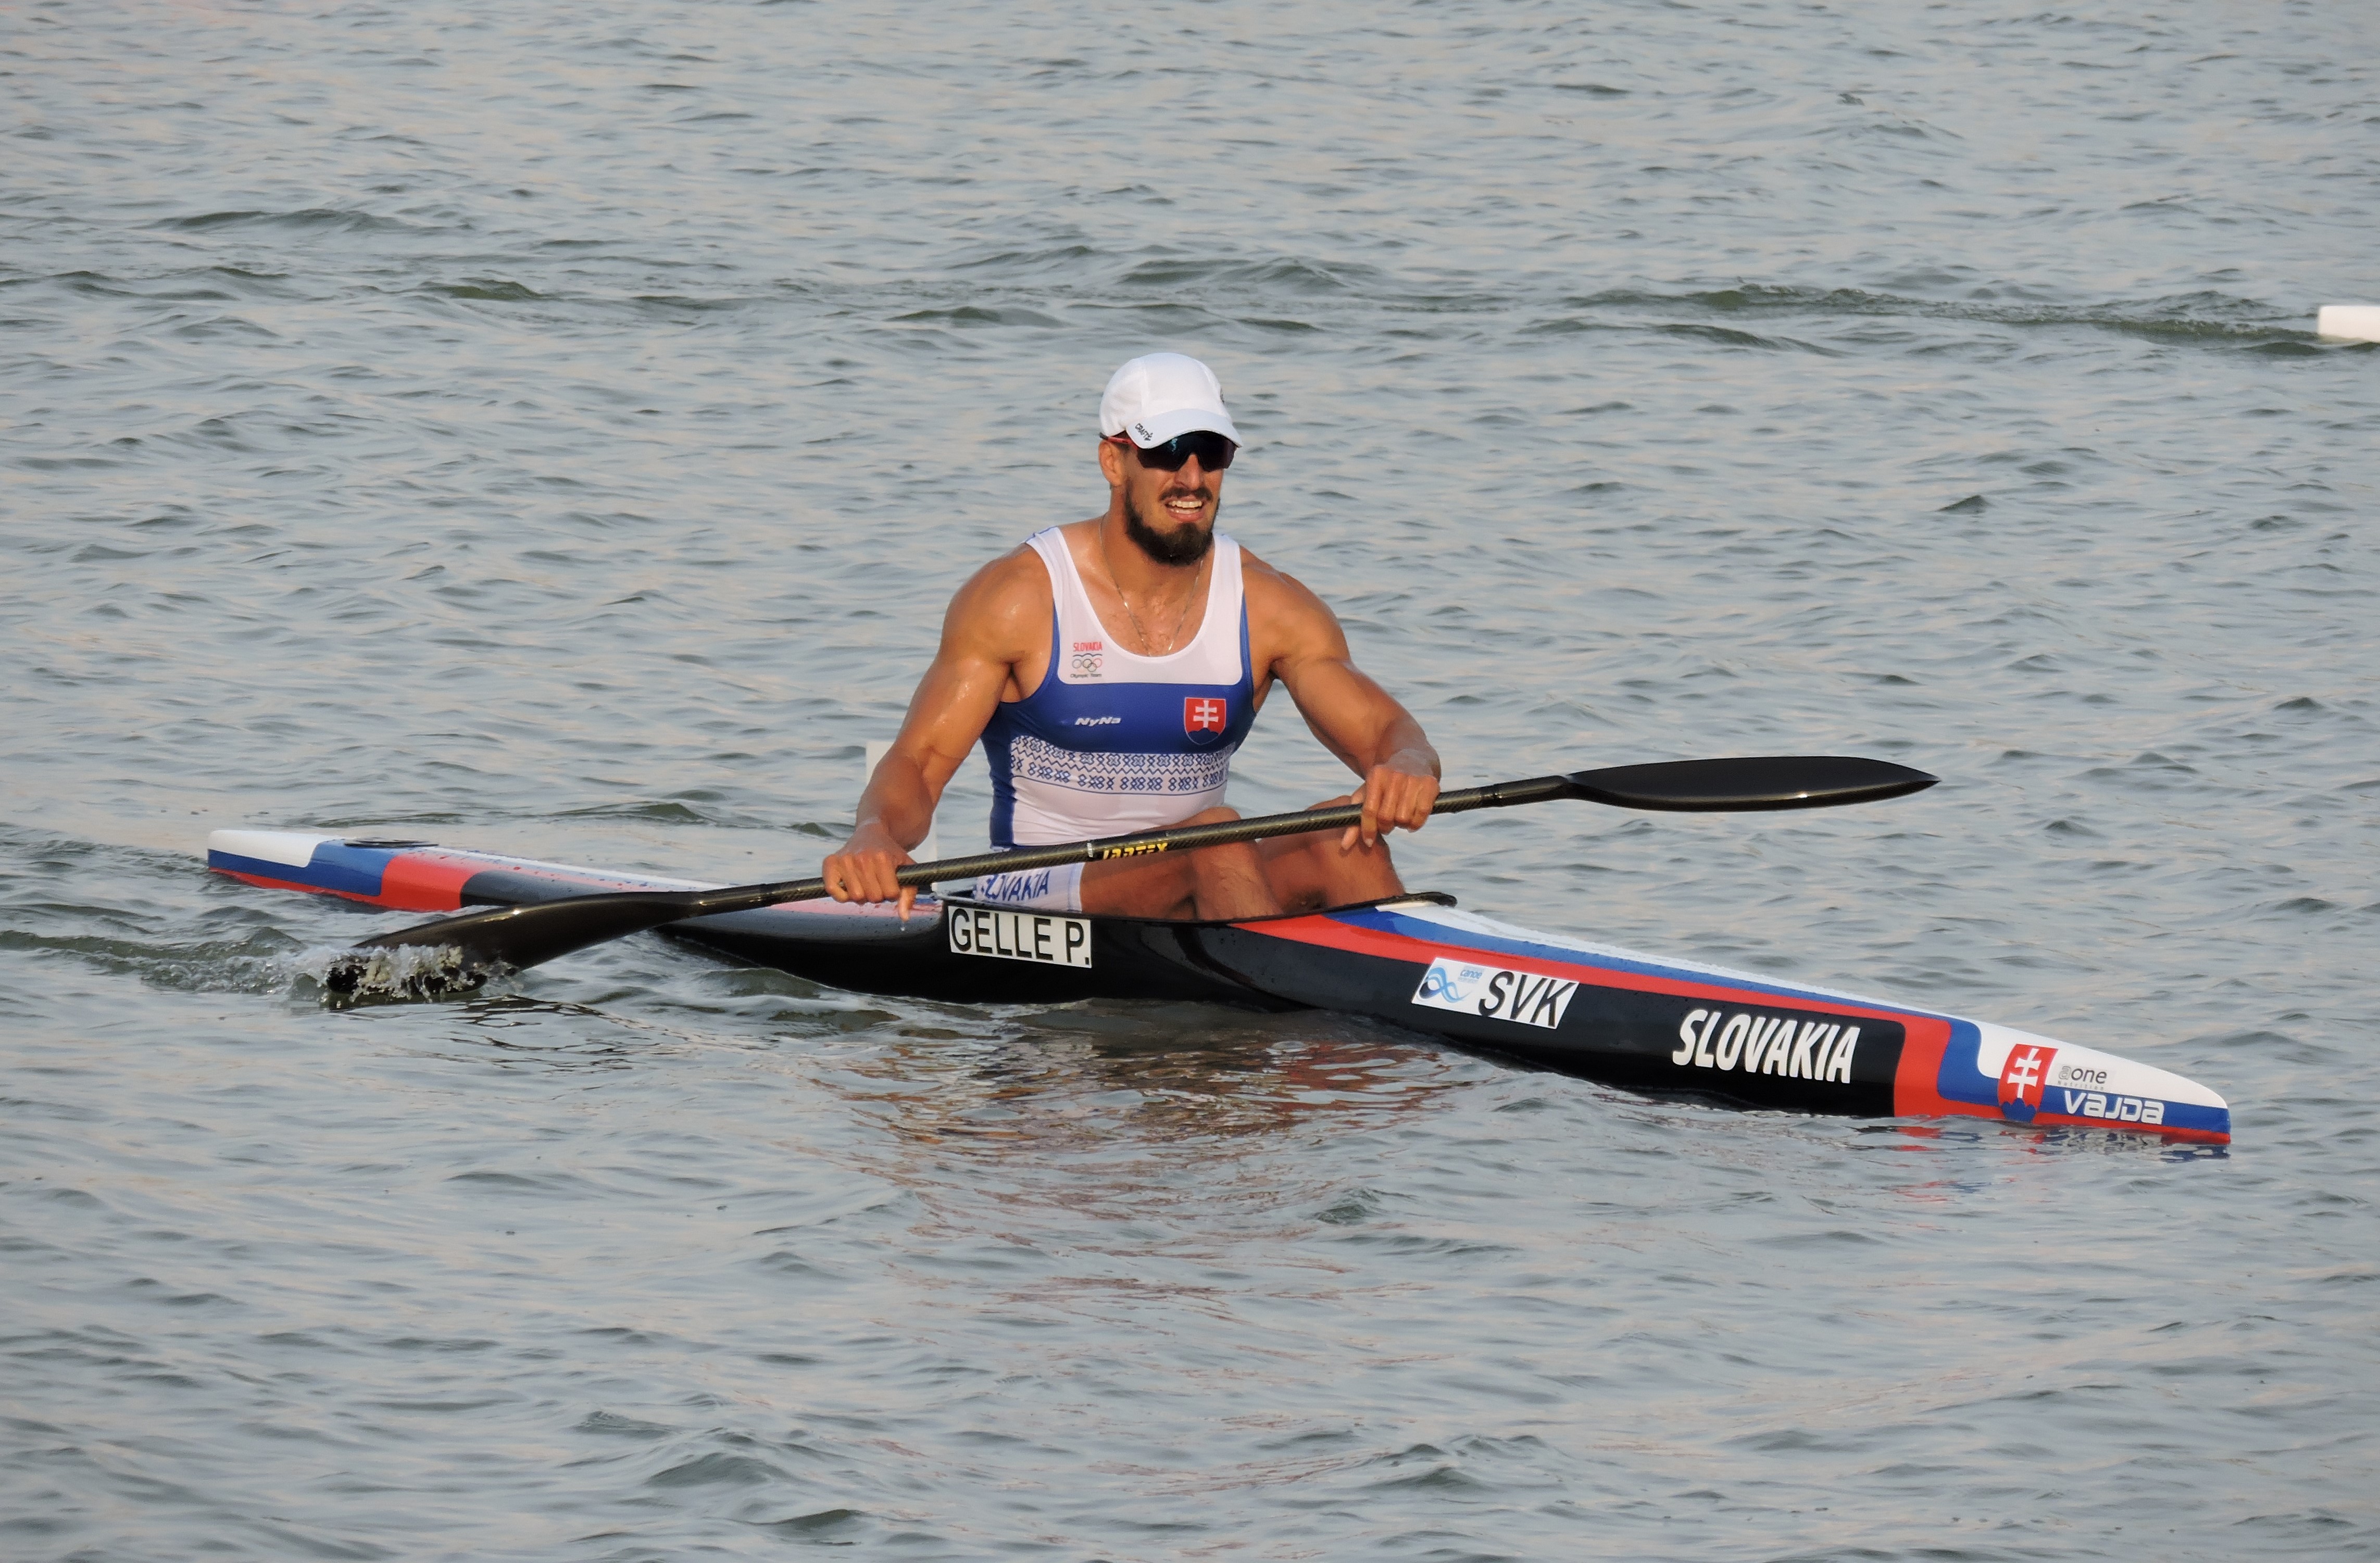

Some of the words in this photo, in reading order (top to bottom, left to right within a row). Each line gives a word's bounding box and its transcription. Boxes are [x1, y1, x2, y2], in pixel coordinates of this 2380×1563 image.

[1073, 642, 1103, 652] SLOVAKIA
[951, 908, 1054, 961] GELLE
[1066, 921, 1089, 965] P.
[1460, 969, 1483, 979] canoe
[1478, 971, 1577, 1027] SVK
[1672, 1009, 1861, 1084] SLOVAKIA
[2057, 1080, 2104, 1092] Nutrition
